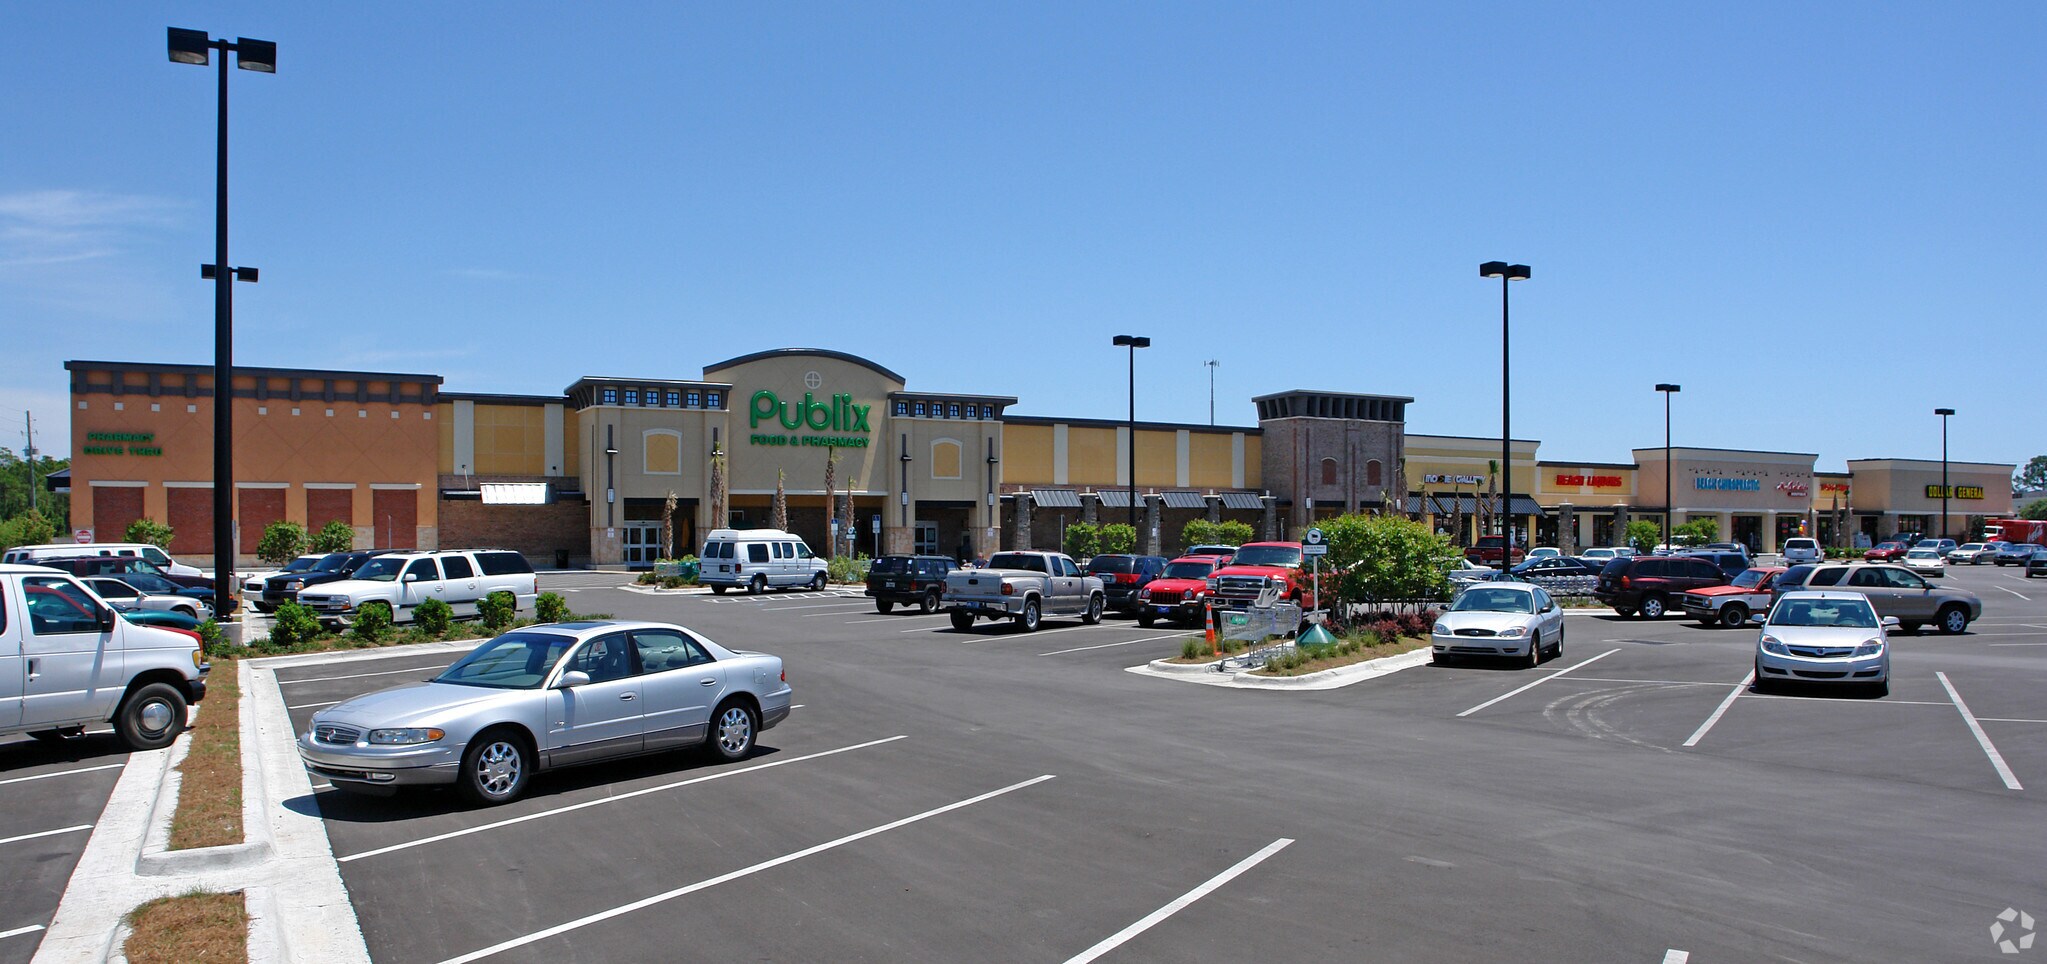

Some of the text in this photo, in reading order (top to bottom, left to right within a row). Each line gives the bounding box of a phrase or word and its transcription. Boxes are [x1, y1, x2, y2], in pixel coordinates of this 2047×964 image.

[750, 389, 871, 432] Publix
[87, 432, 155, 442] PHARMACY
[750, 434, 870, 448] FOOD & PHARMACY
[83, 446, 162, 456] DRIVE THRU
[1957, 486, 1985, 499] GENERAL
